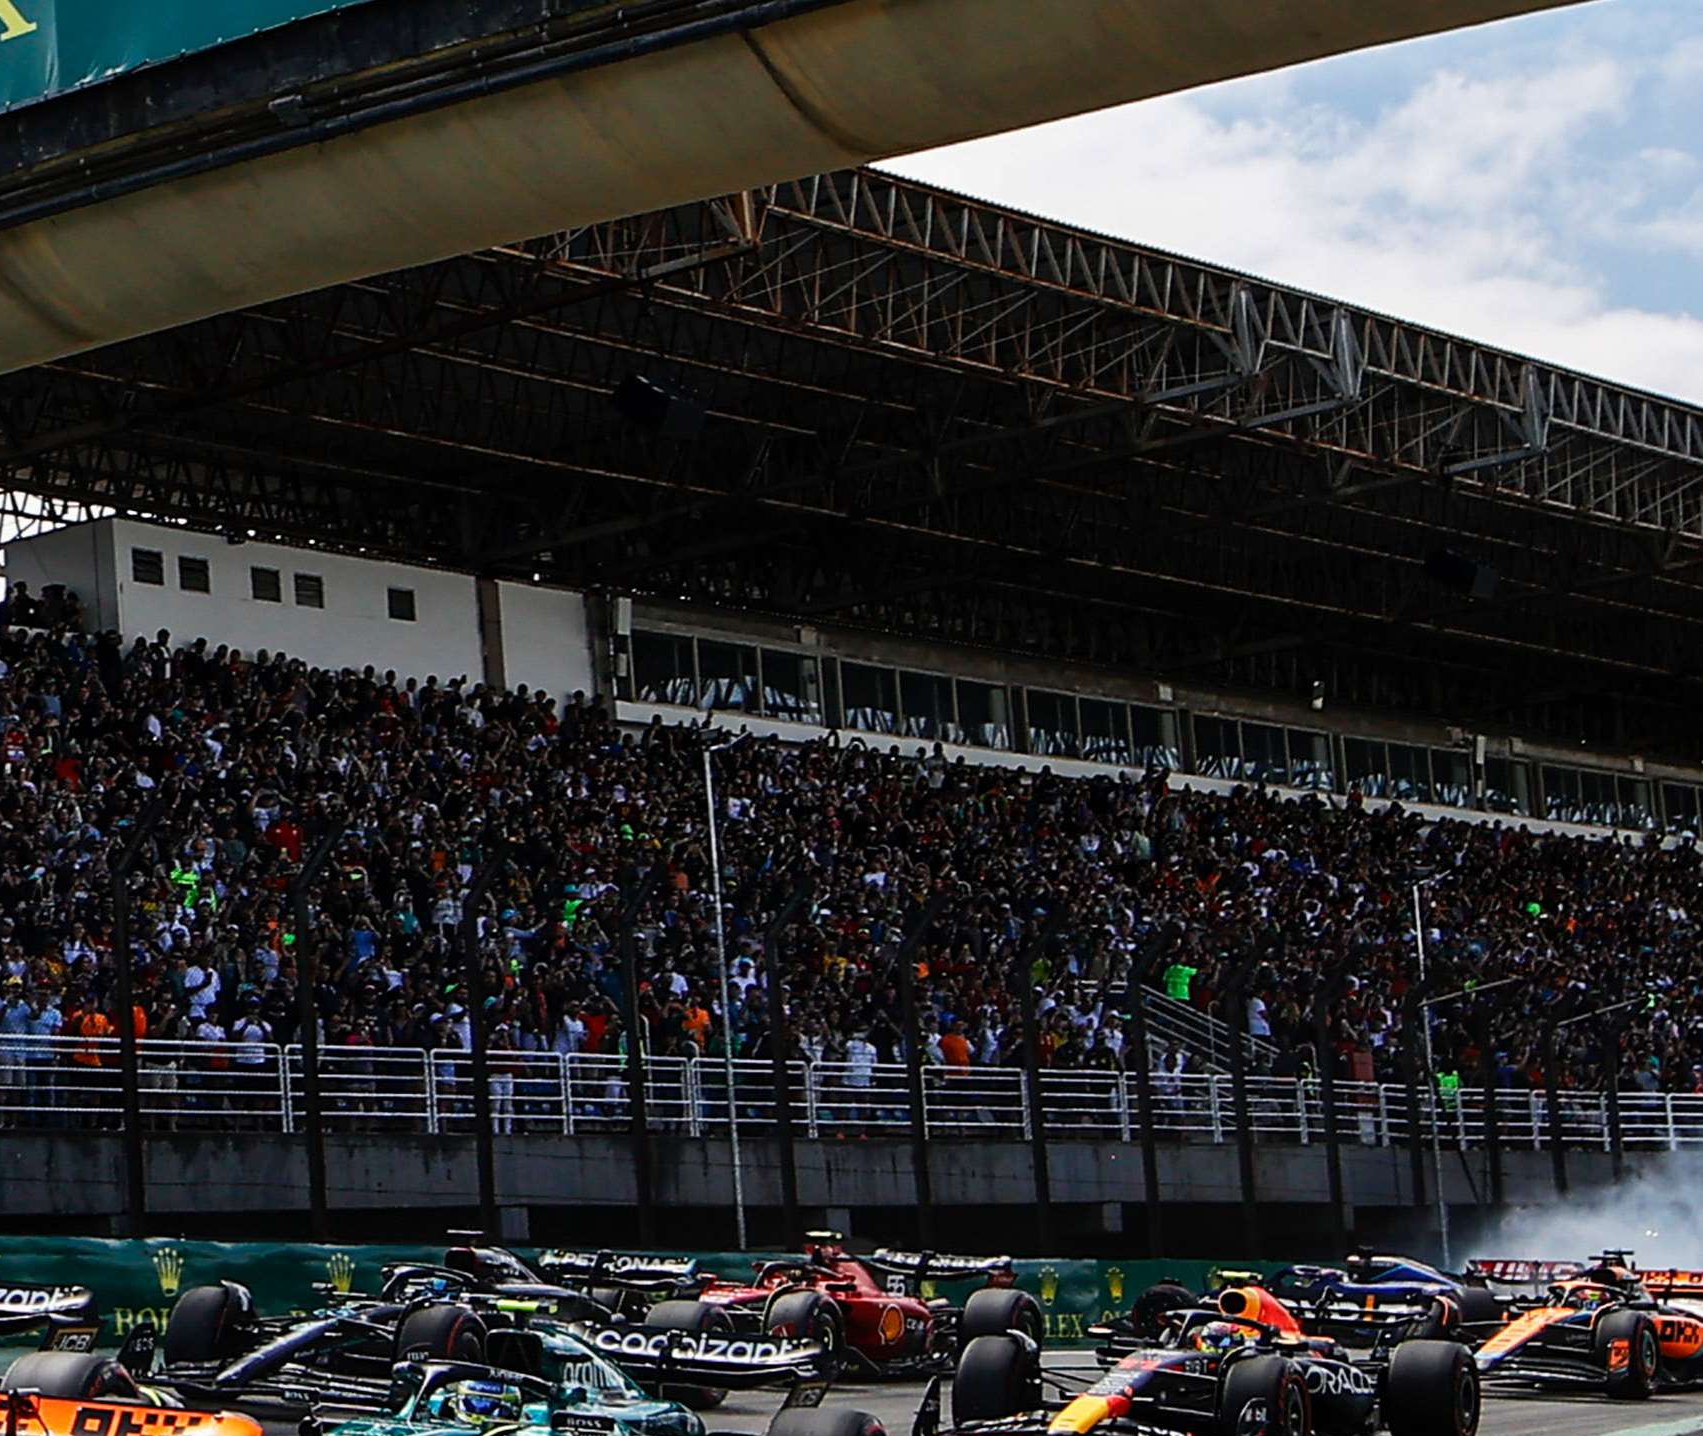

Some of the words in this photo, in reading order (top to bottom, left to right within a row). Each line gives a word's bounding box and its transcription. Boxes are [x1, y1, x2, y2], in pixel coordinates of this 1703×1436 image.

[1043, 1314, 1084, 1338] LEX
[55, 1333, 92, 1351] JCB
[1306, 1366, 1378, 1395] ORACLE
